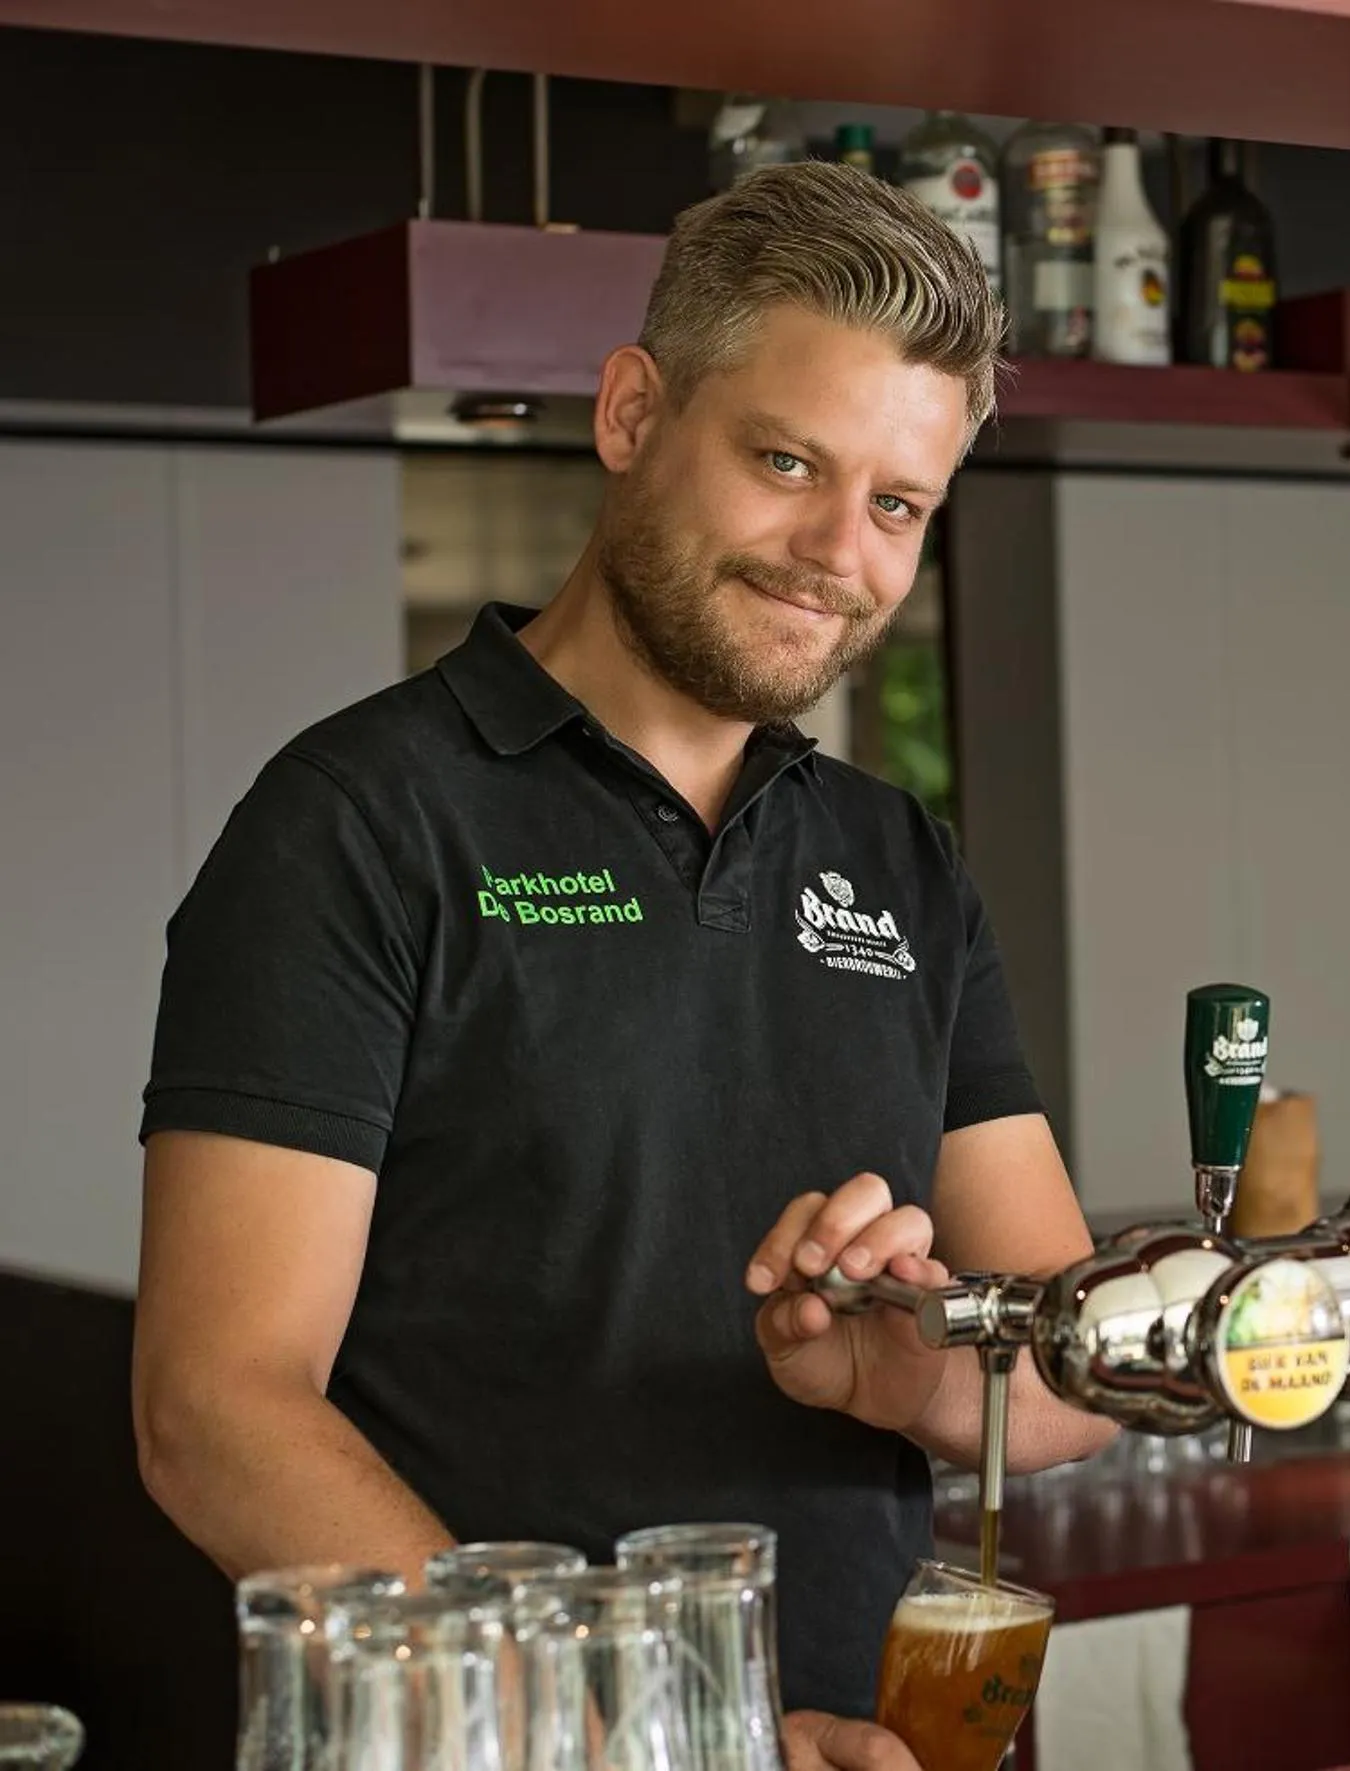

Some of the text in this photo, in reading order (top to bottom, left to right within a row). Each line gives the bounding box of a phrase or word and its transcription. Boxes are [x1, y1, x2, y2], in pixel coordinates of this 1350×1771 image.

[514, 897, 643, 925] Bosrand
[800, 887, 901, 941] Brand
[845, 944, 874, 957] 1340
